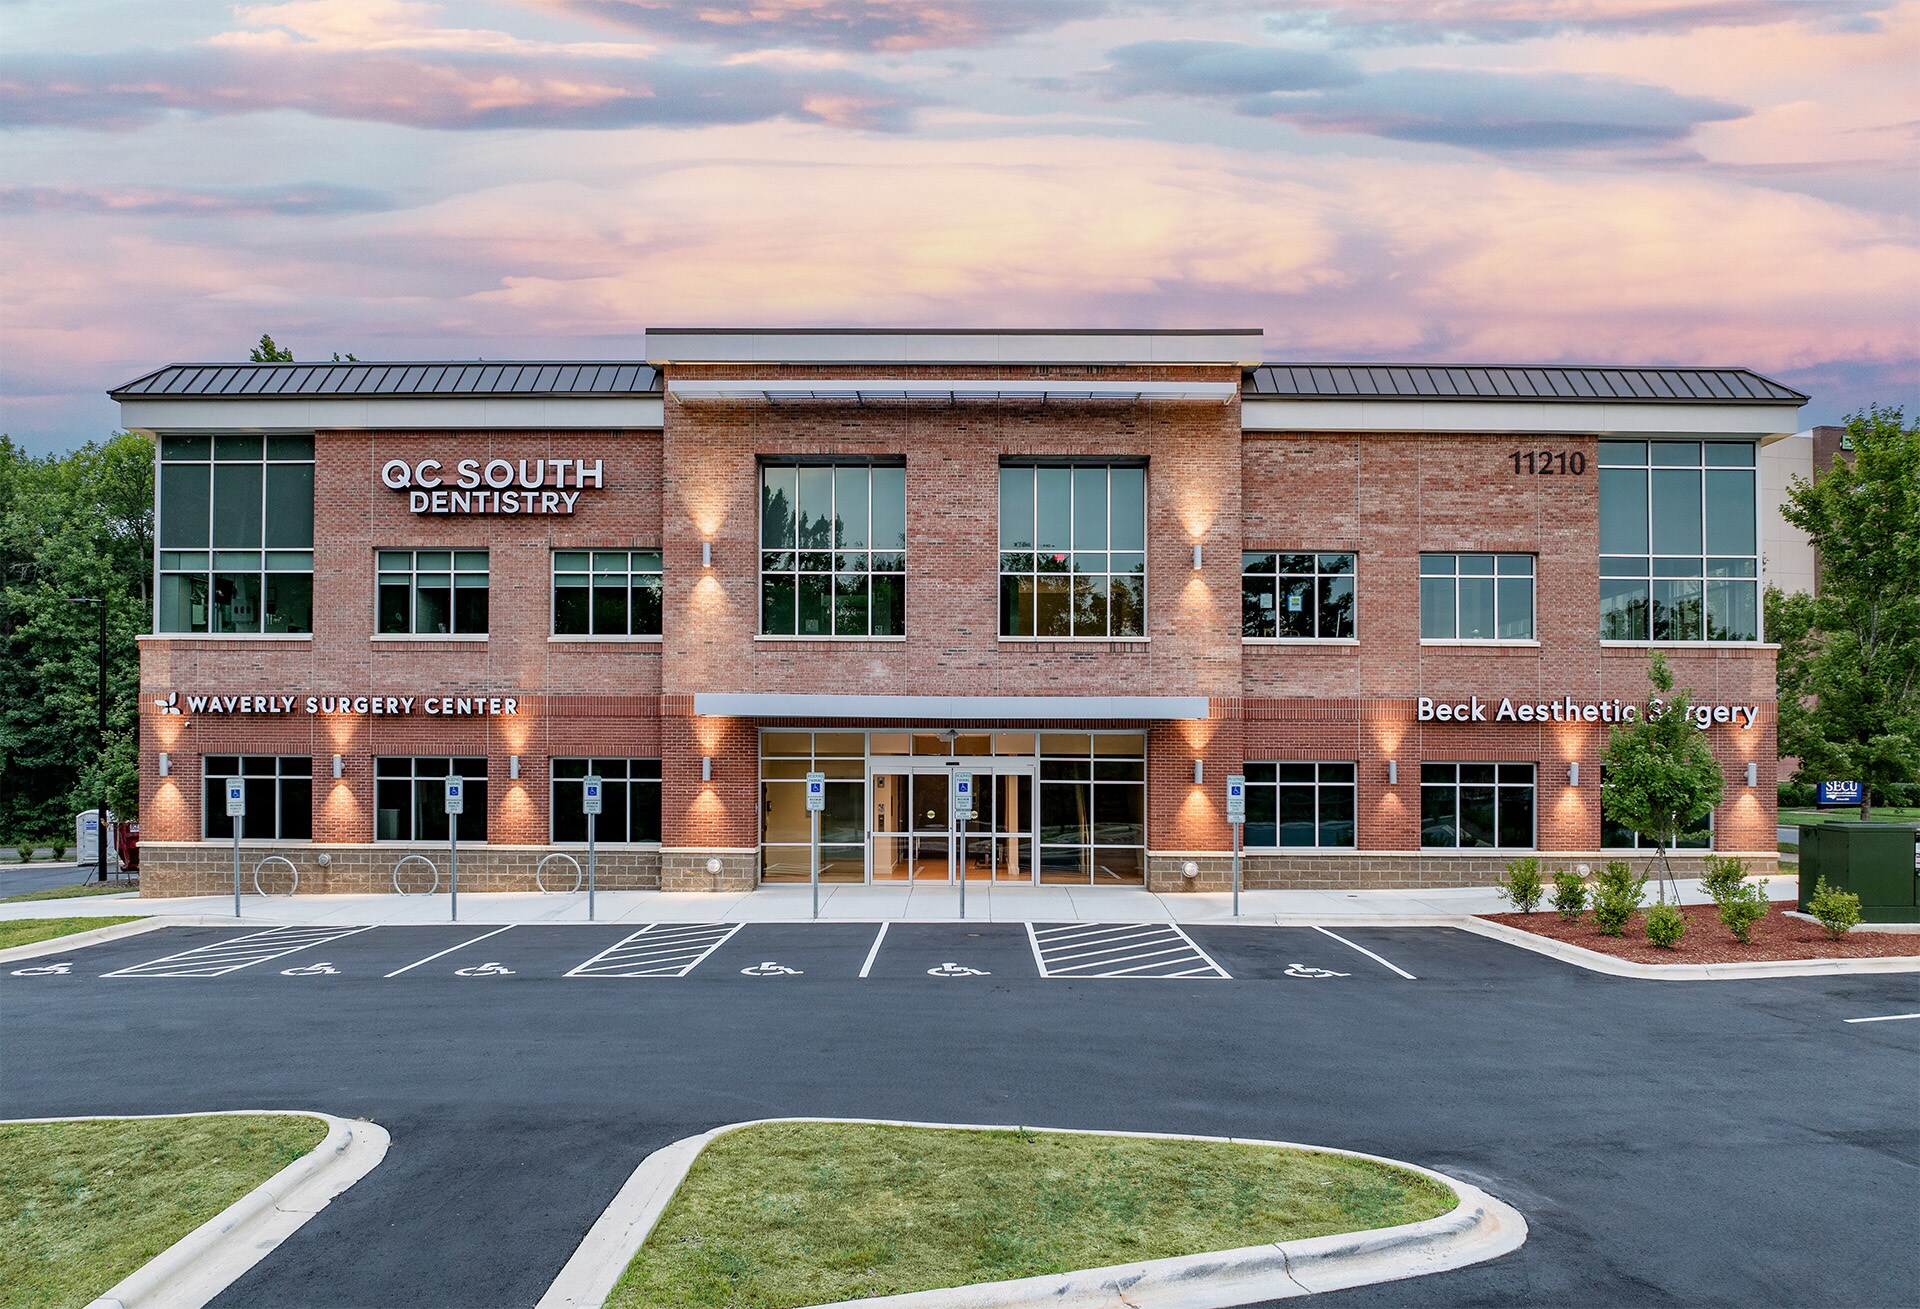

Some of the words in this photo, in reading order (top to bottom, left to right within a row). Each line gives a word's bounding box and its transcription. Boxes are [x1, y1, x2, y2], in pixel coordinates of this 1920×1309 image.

[381, 459, 443, 489] QC
[456, 459, 604, 489] SOUTH
[1509, 451, 1586, 475] 11210
[409, 491, 580, 513] DENTISTRY
[187, 696, 295, 713] WAVERLY
[306, 697, 415, 714] SURGERY
[424, 698, 518, 715] CENTER
[1417, 696, 1487, 721] Beck
[1495, 696, 1637, 722] Aesthetic
[1649, 699, 1759, 730] Srgery
[1826, 780, 1858, 792] SECU
